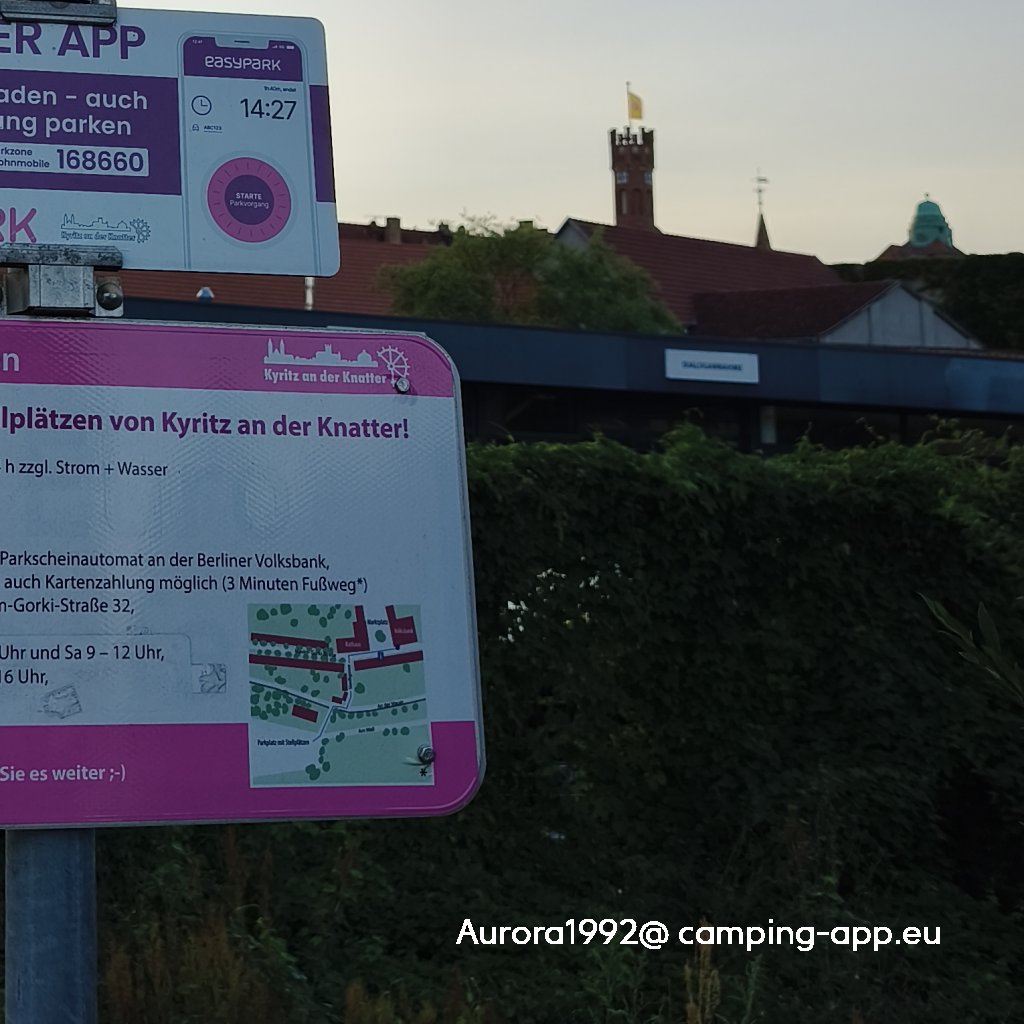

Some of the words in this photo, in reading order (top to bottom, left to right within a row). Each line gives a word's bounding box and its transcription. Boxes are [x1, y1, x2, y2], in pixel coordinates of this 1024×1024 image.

[58, 23, 146, 61] APP
[85, 90, 148, 111] auch
[240, 98, 297, 120] 14:27
[45, 114, 132, 138] parken
[57, 149, 144, 172] 168660
[230, 200, 269, 209] Parkvorgang
[264, 369, 299, 384] Kyritz
[302, 373, 317, 382] an
[320, 370, 340, 383] der
[342, 371, 387, 384] Knatter
[110, 414, 154, 432] von
[162, 412, 232, 438] Kyritz
[238, 418, 266, 436] an
[272, 414, 312, 437] der
[317, 416, 409, 439] Knatter!
[5, 458, 15, 473] h
[19, 458, 52, 477] zzgl.
[56, 460, 100, 476] Strom
[117, 461, 168, 476] Wasser
[0, 551, 143, 567] Parkscheinautomat
[147, 556, 166, 567] an
[170, 553, 193, 568] der
[197, 553, 252, 569] Berliner
[255, 553, 330, 571] Volksbank,
[4, 574, 41, 590] auch
[45, 575, 155, 593] Kartenzahlung
[159, 575, 218, 593] möglich
[222, 576, 236, 592] (3
[240, 576, 298, 591] Minuten
[112, 599, 135, 616] 32,
[31, 645, 61, 661] und
[64, 645, 83, 661] Sa
[87, 646, 95, 660] 9
[112, 646, 130, 660] 12
[134, 645, 165, 662] Uhr,
[18, 669, 49, 687] Uhr,
[0, 766, 25, 782] Sie
[29, 769, 48, 781] es
[52, 765, 105, 781] weiter
